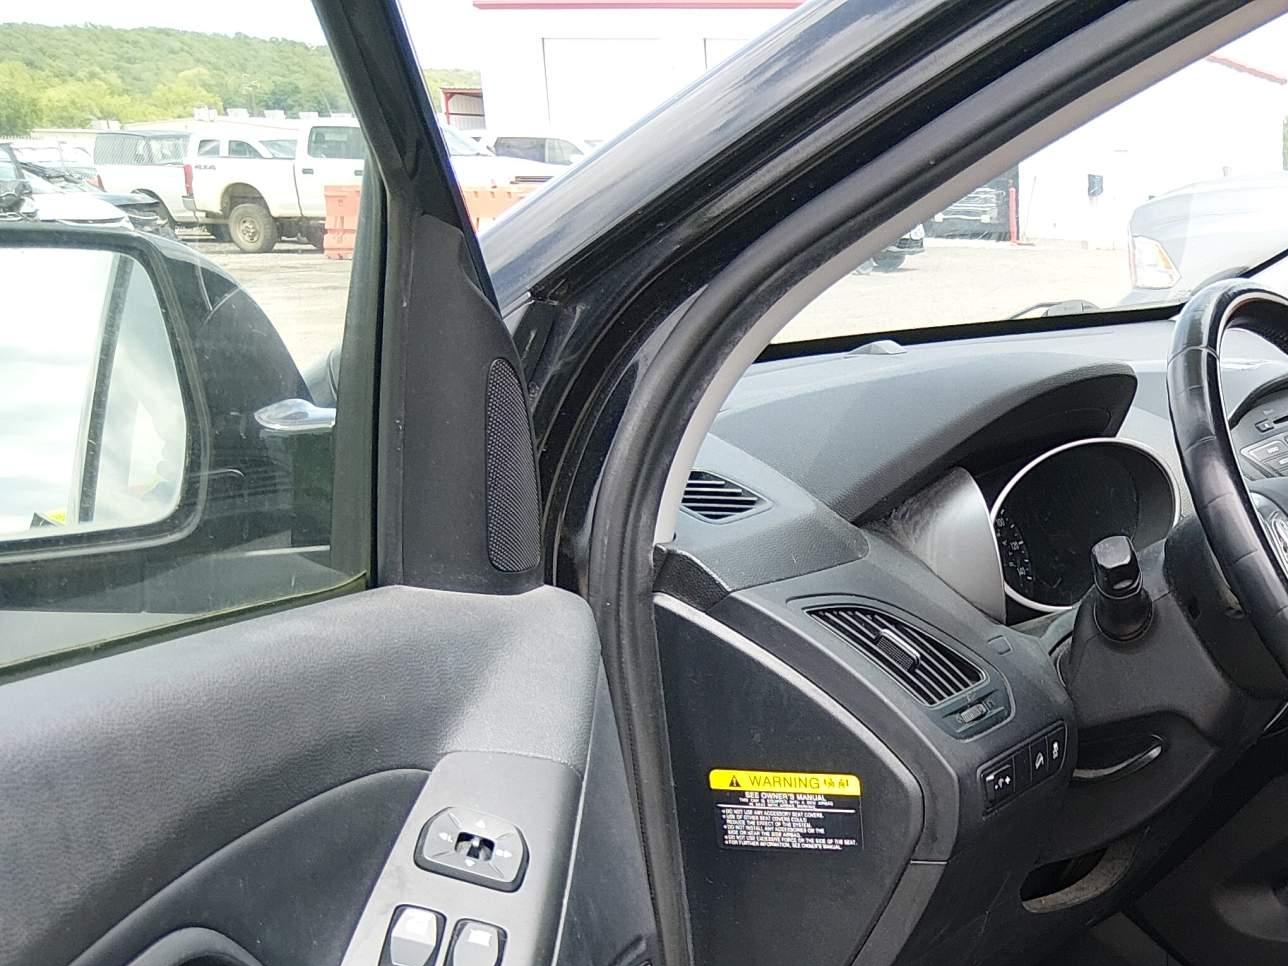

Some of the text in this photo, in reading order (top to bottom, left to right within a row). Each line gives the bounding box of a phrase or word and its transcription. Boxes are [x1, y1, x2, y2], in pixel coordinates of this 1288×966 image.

[749, 775, 820, 790] WARNING
[745, 791, 826, 801] SEE OWNER'S MANUAL
